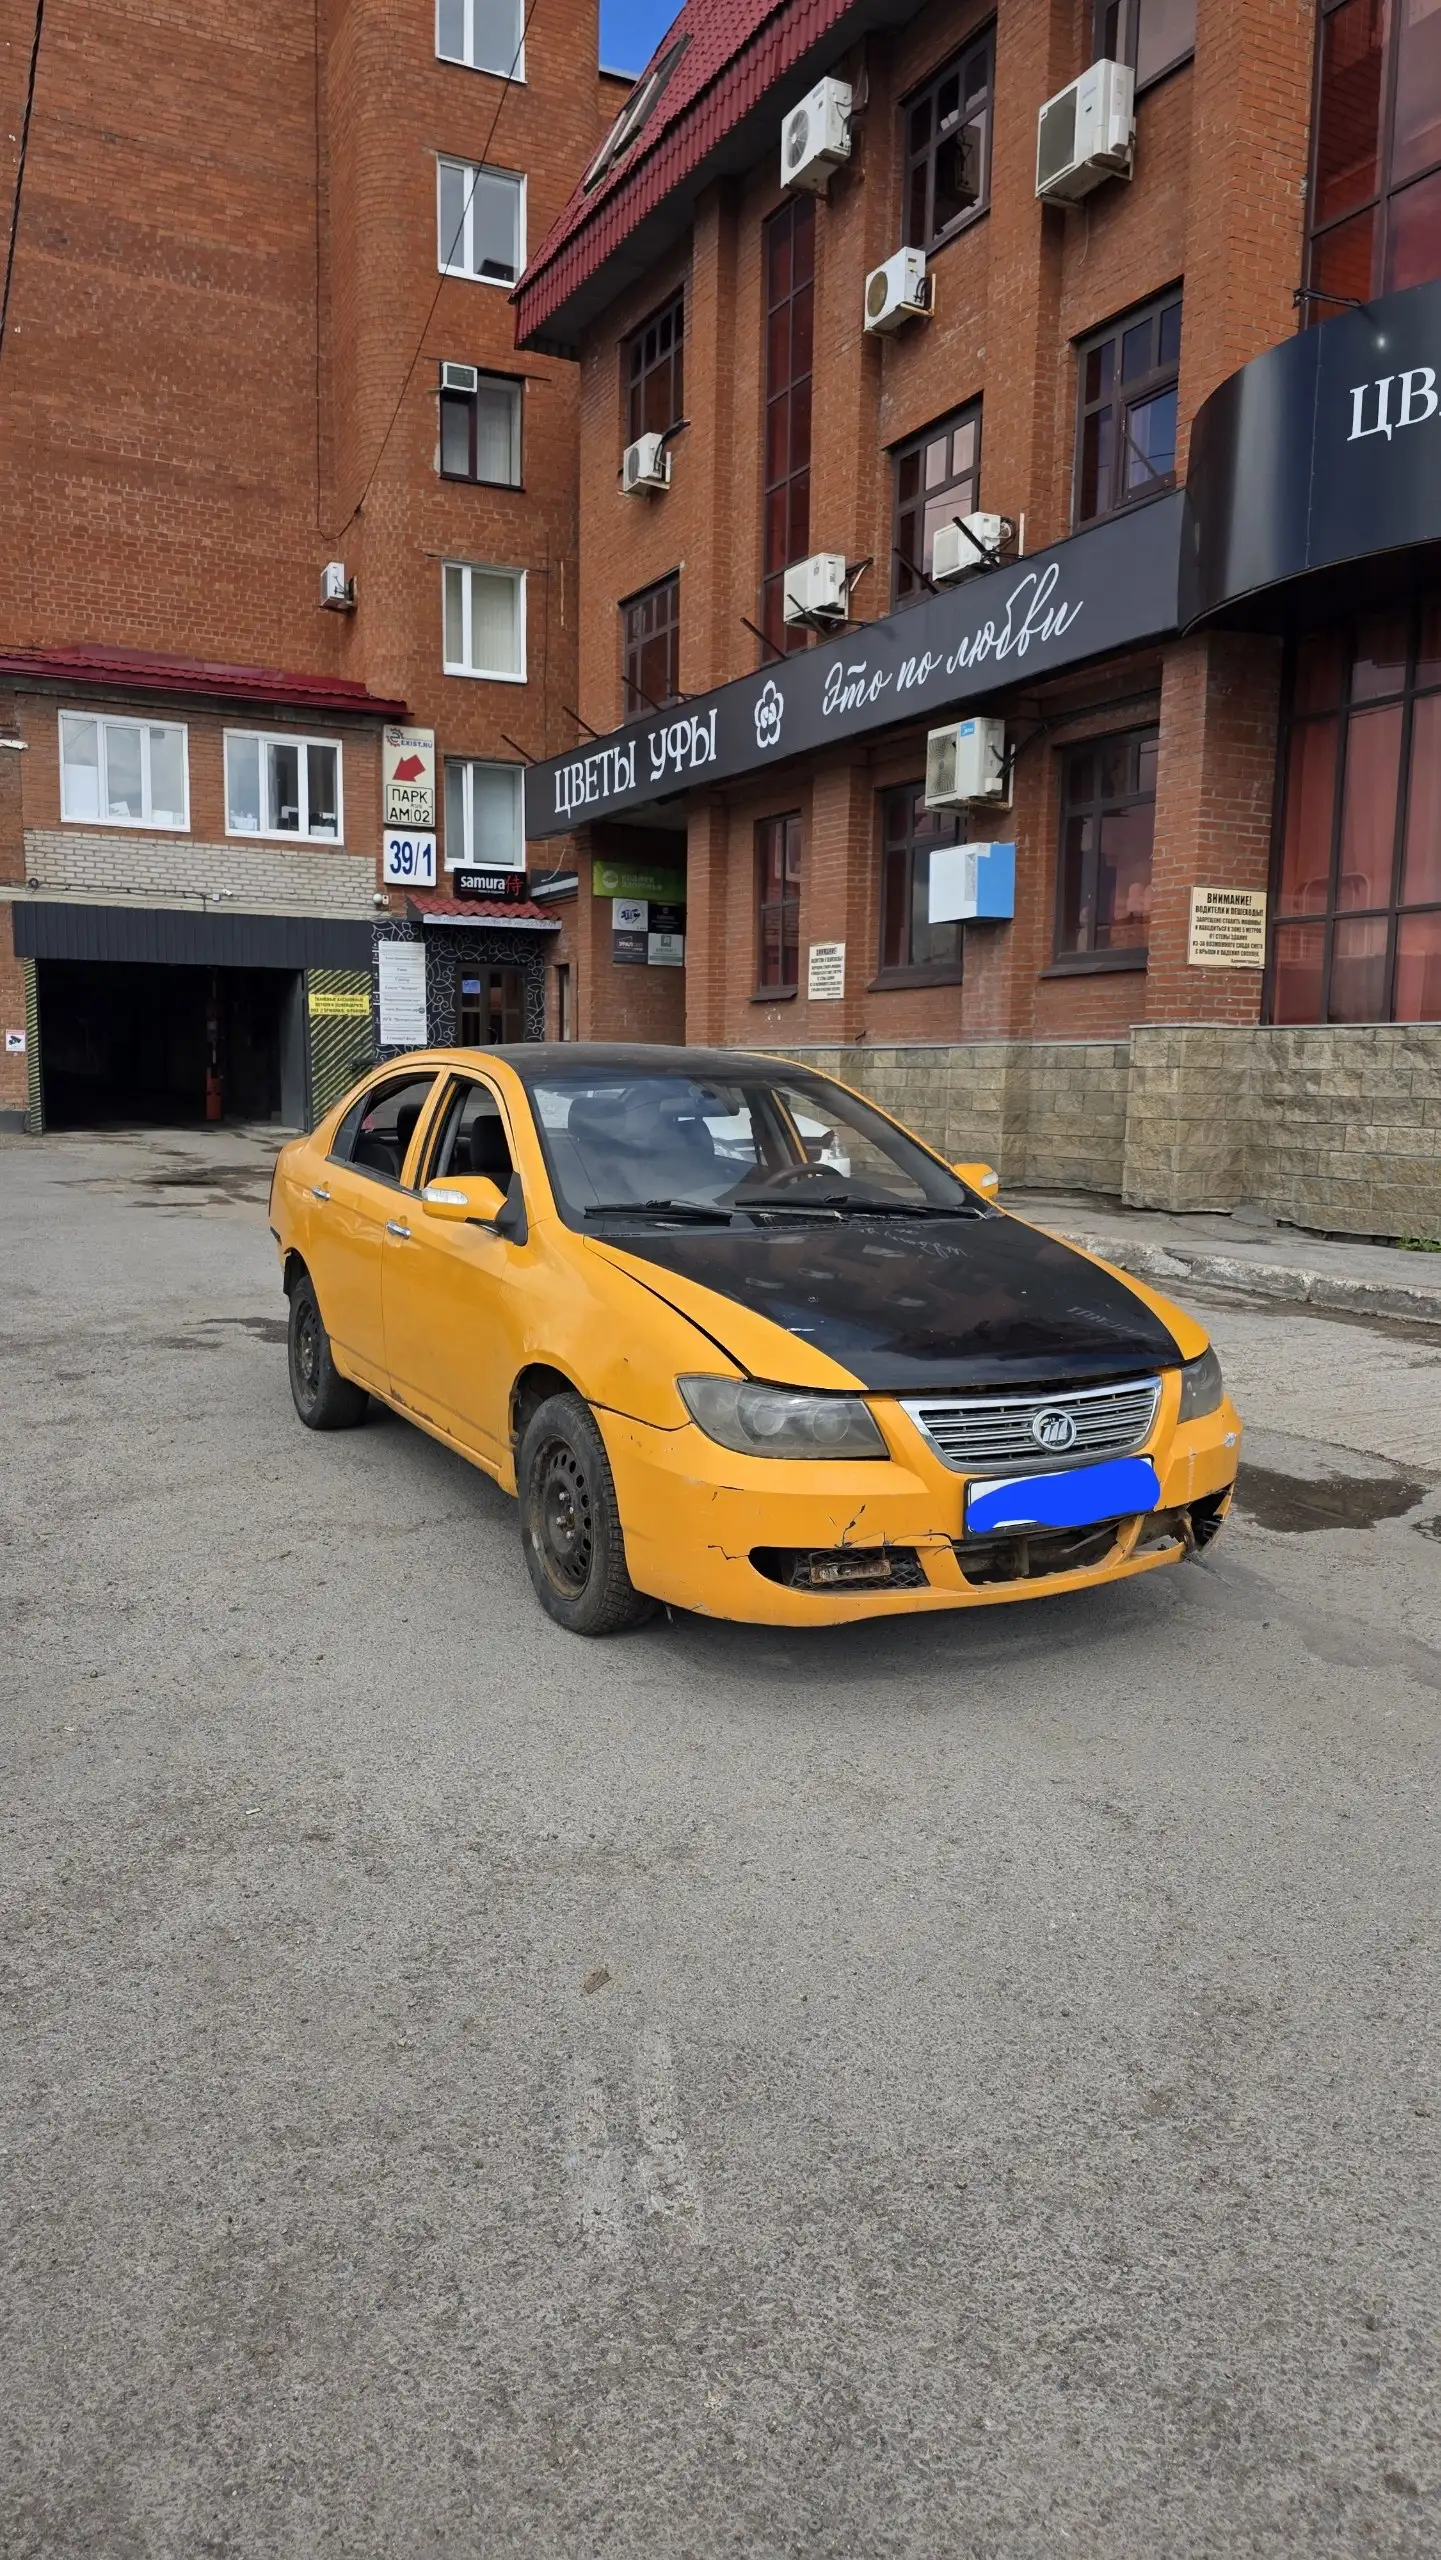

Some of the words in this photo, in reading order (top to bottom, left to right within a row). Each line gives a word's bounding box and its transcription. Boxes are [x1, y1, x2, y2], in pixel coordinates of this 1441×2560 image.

[1346, 367, 1441, 441] ЦВ
[822, 660, 893, 716] Это
[896, 651, 943, 692] по
[946, 562, 1084, 675] любви
[554, 740, 636, 819] ЦВЕТЫ
[648, 708, 718, 782] УФЫ
[392, 788, 428, 804] ПАРК
[413, 809, 430, 823] 02
[389, 839, 432, 877] 39/1
[460, 875, 506, 890] samura
[1206, 892, 1252, 906] ВНИМАНИЕ!
[1195, 905, 1225, 914] ВОДИТЕЛИ
